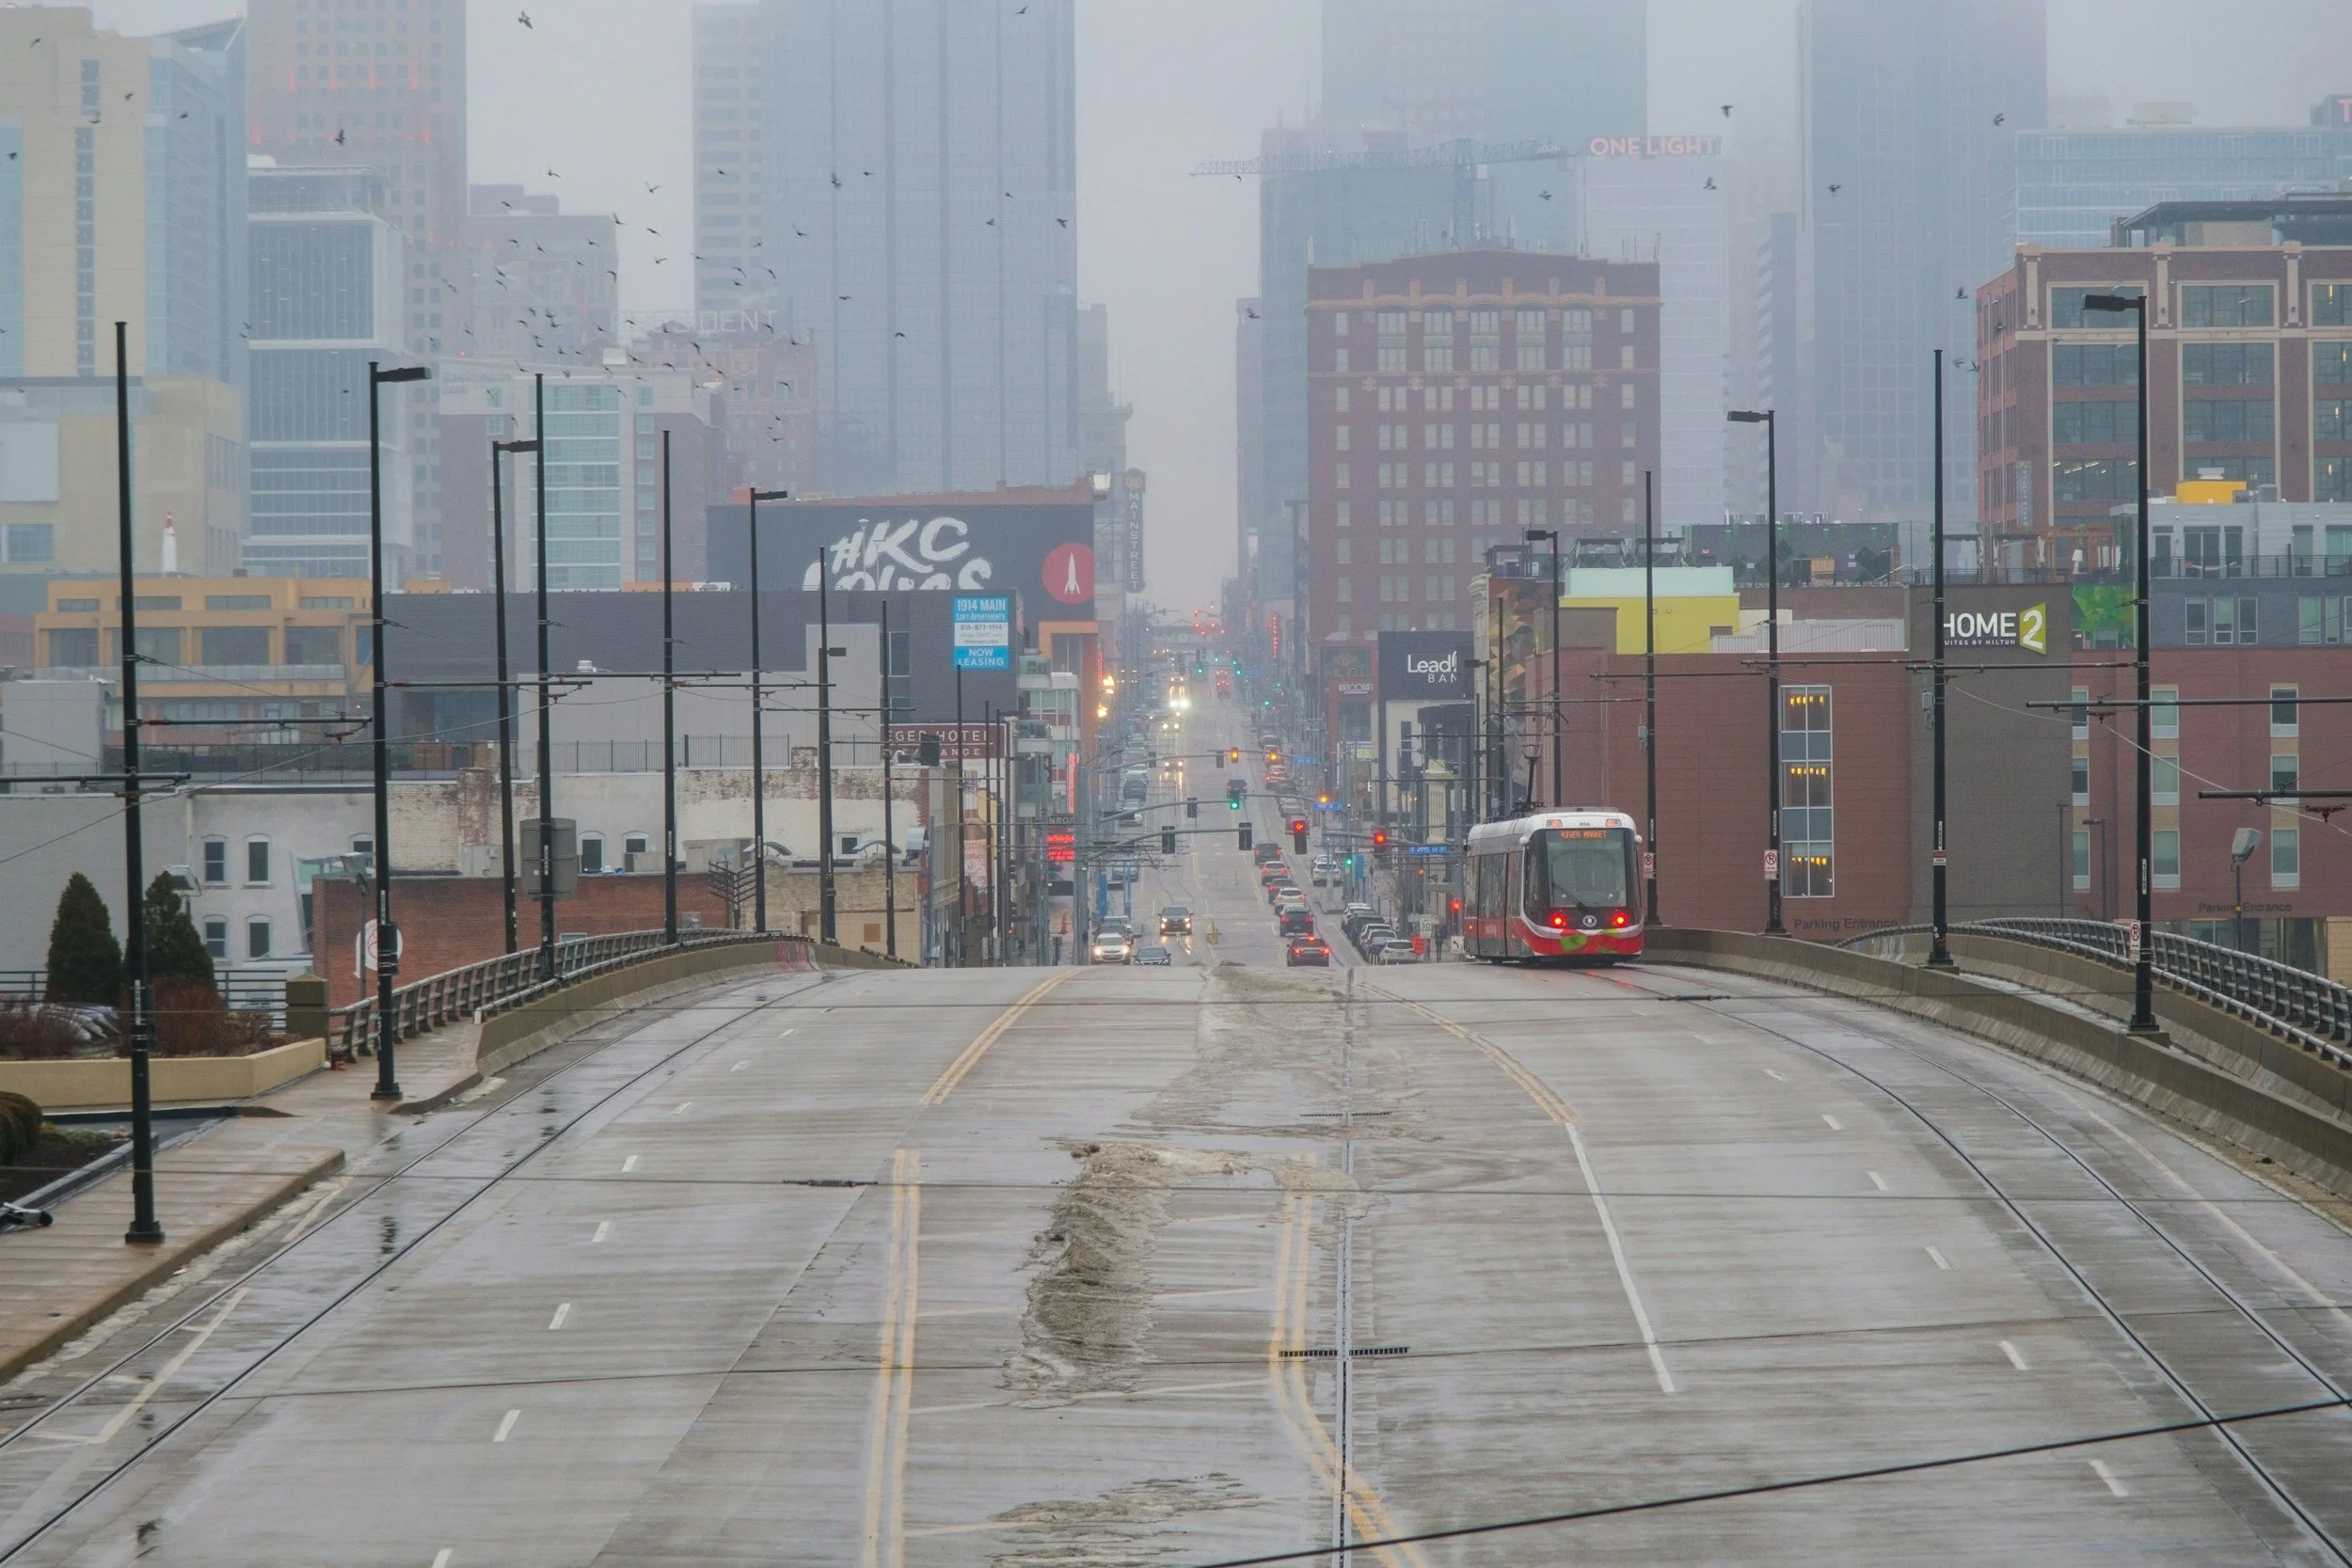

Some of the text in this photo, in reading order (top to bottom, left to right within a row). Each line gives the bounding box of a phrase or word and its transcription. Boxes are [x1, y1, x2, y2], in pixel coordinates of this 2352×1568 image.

[1590, 136, 1714, 155] ONE LIGHT
[830, 516, 970, 574] #KC
[957, 599, 1006, 611] 1914 MAIN
[1944, 610, 2043, 649] HOME 2
[969, 648, 994, 657] NOW
[958, 657, 1004, 666] LEASING
[1428, 673, 1457, 683] BAN
[1561, 830, 1607, 838] RIVER MARKET
[2199, 902, 2293, 912] Parkin Entrance
[1794, 918, 1898, 932] Parking Entrance
